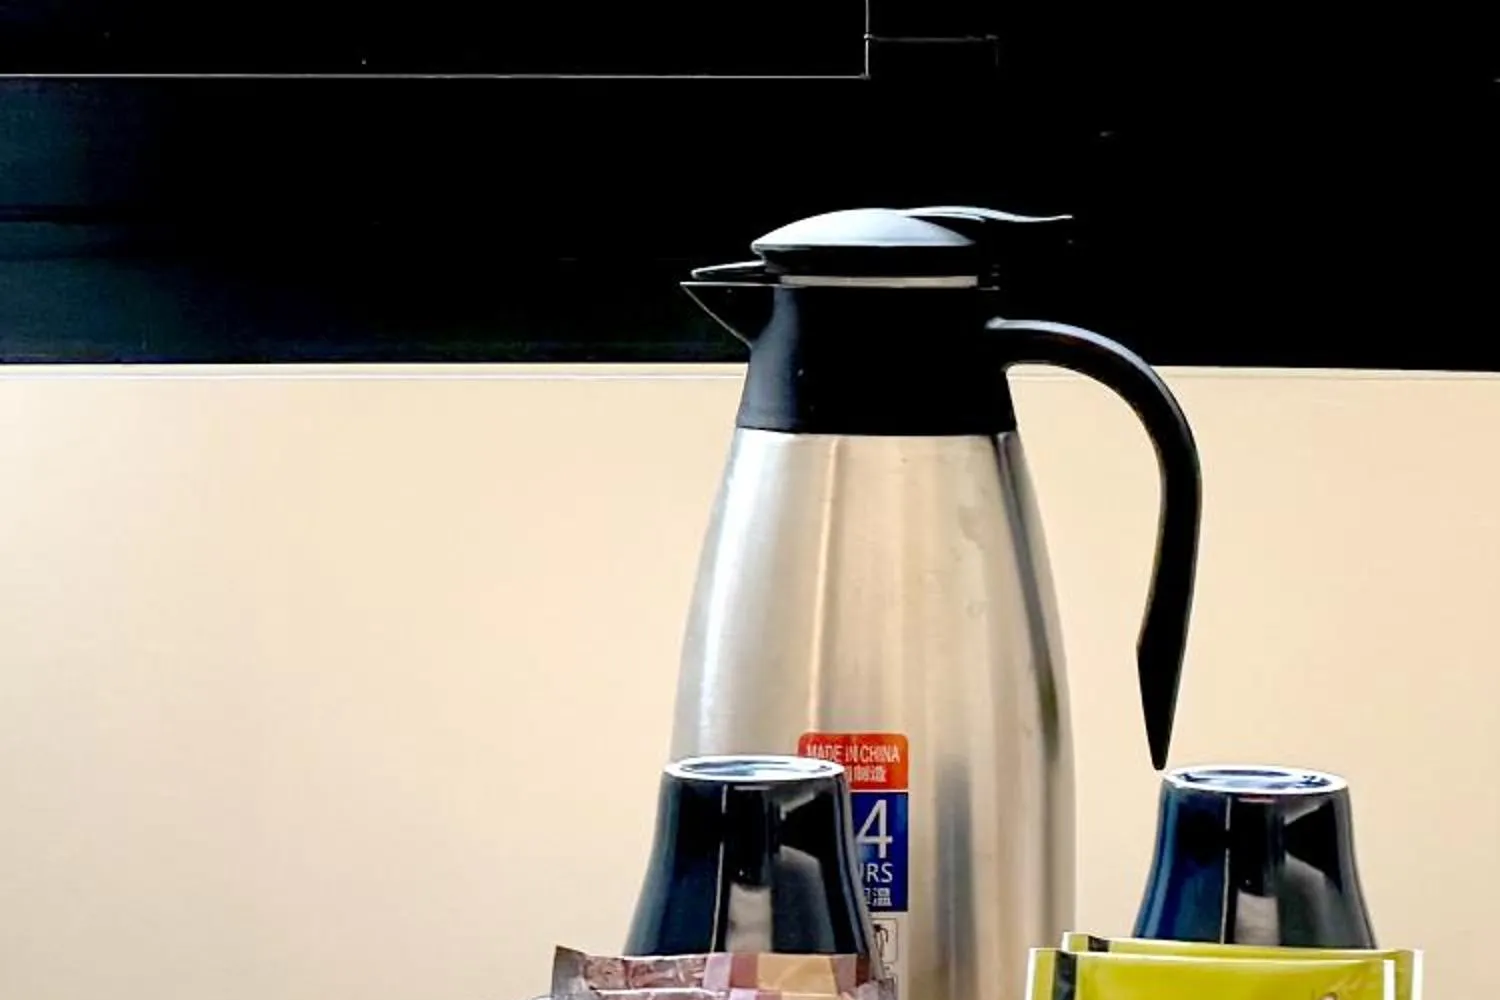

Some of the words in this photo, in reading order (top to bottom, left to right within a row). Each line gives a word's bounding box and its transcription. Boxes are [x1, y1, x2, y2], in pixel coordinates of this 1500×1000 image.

[806, 744, 843, 763] MADE
[845, 745, 858, 763] IN
[861, 745, 900, 763] CHINA
[856, 800, 893, 859] 4
